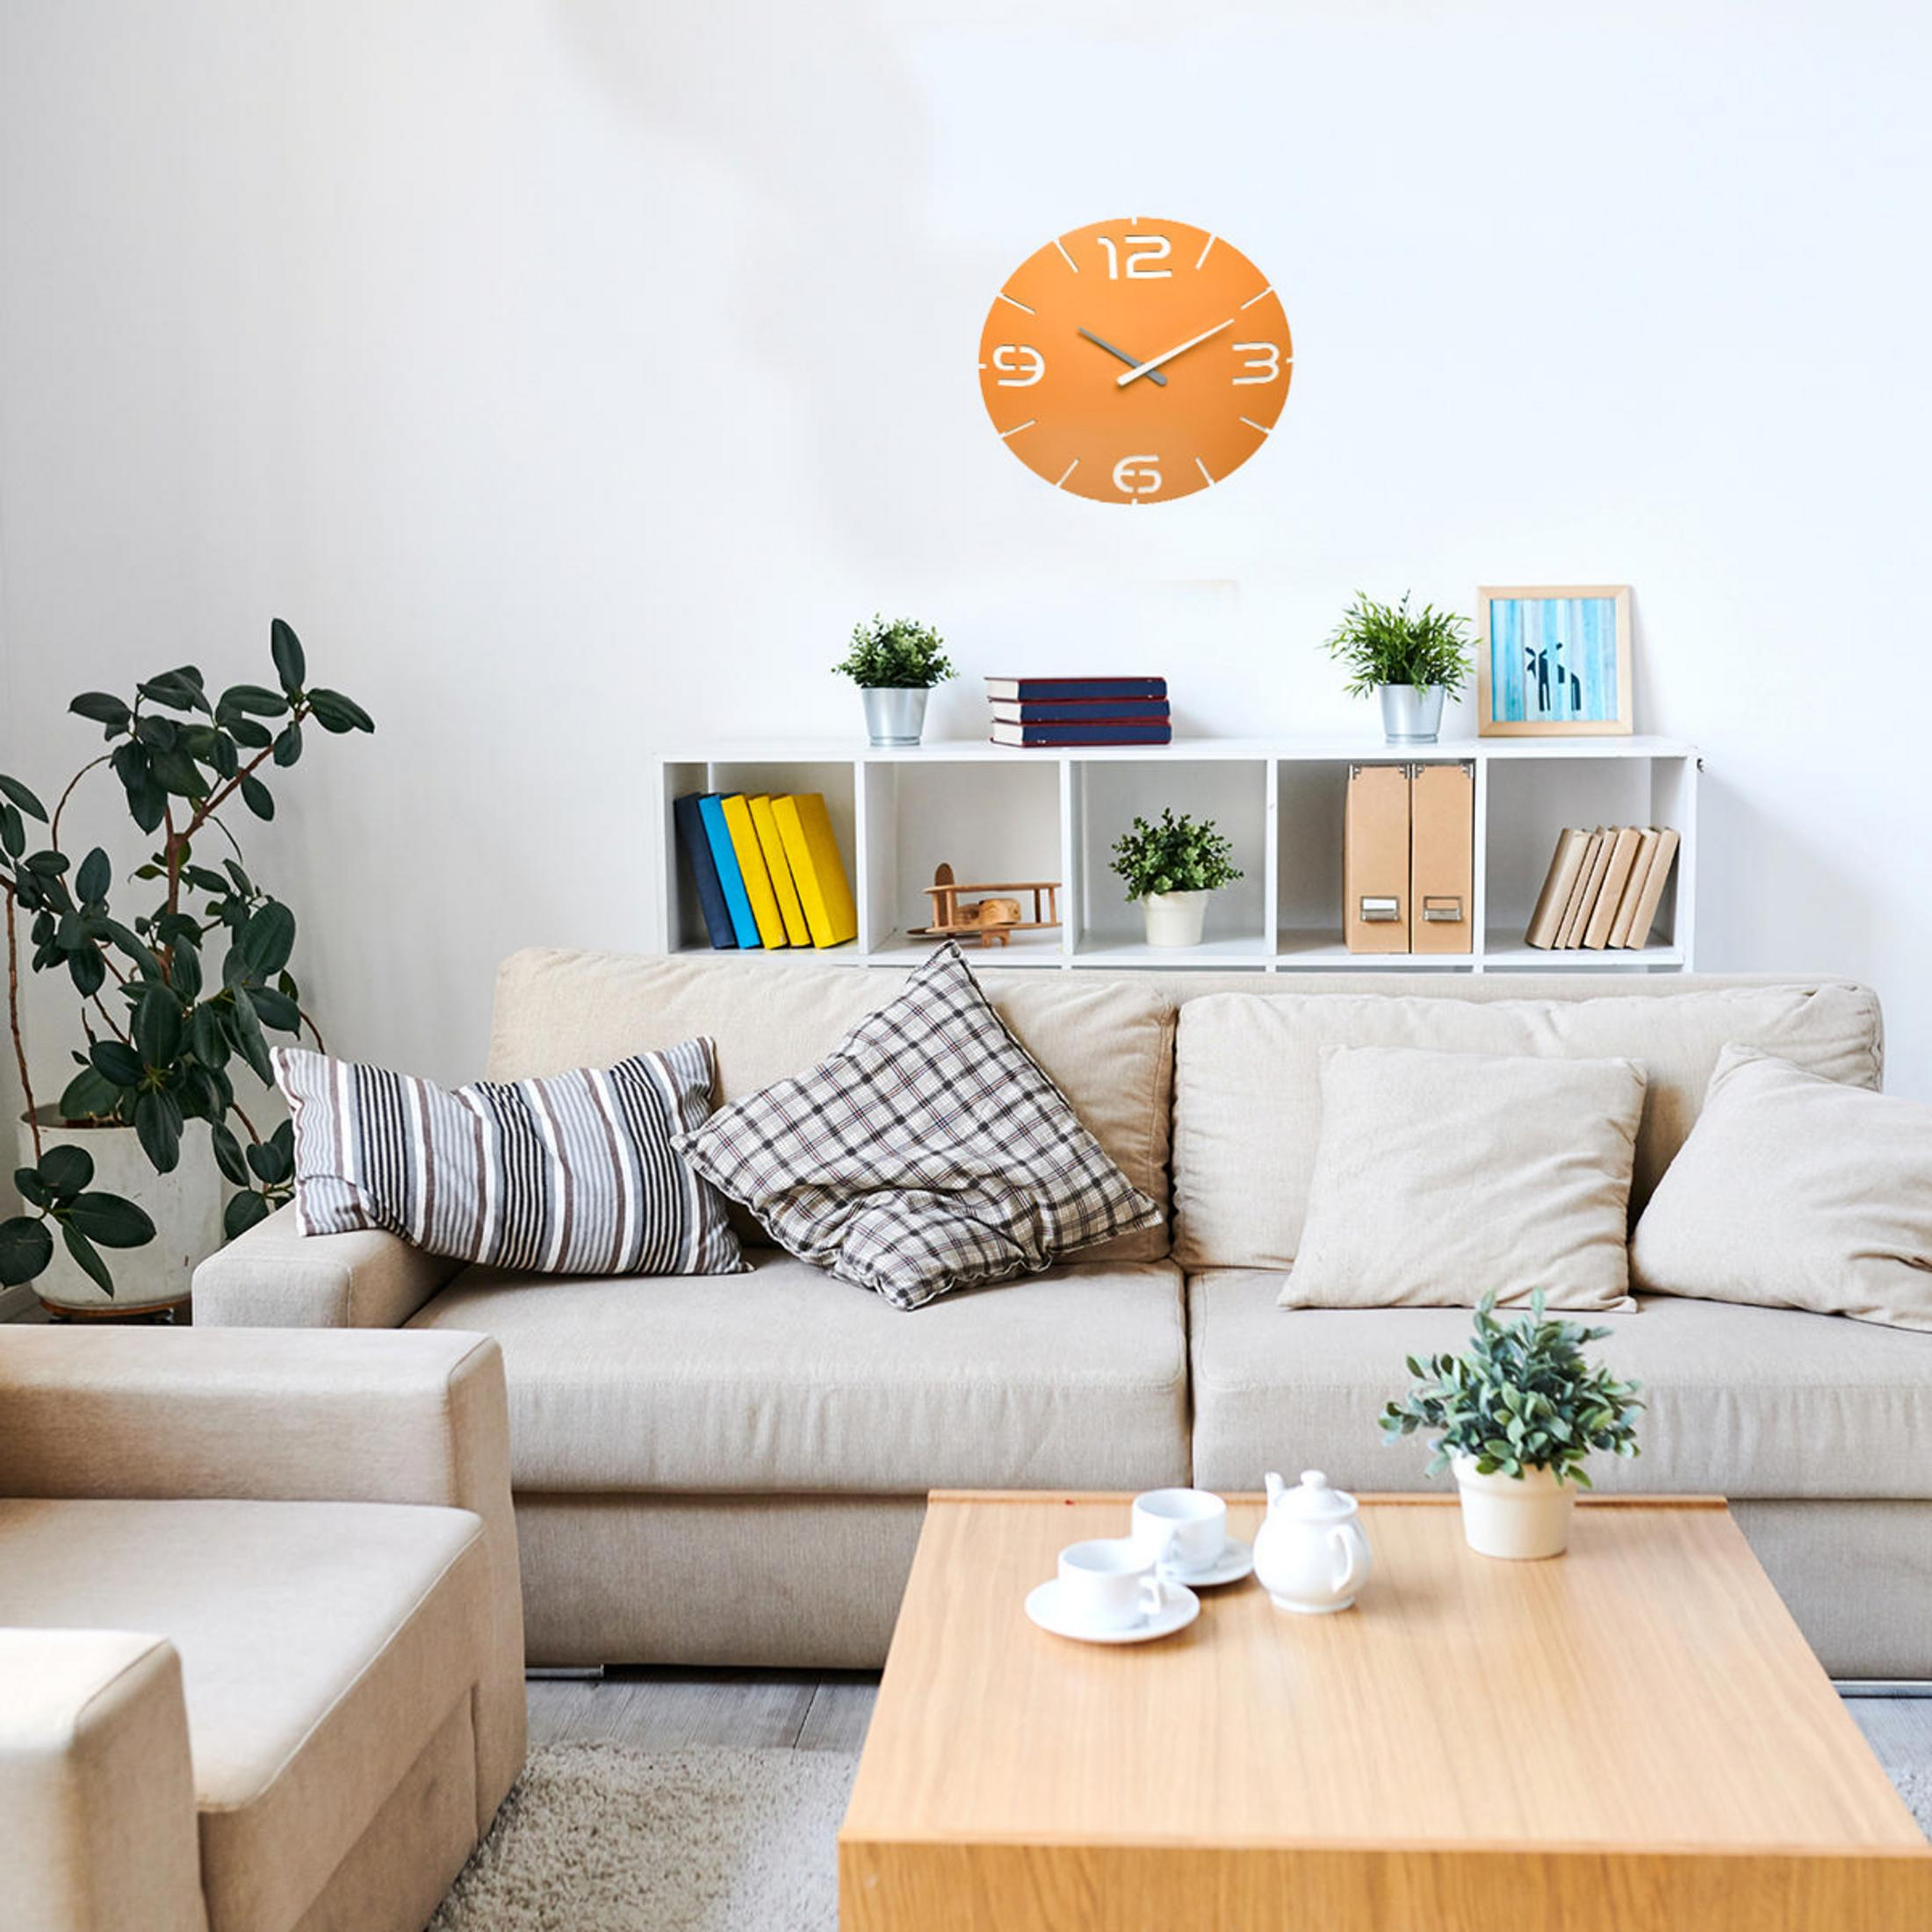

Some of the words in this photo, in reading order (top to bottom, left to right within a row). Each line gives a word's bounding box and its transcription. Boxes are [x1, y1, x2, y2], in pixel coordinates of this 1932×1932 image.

[1097, 234, 1172, 280] 12
[992, 344, 1046, 387] 9
[1232, 342, 1280, 386] 3
[1113, 454, 1163, 494] 6
